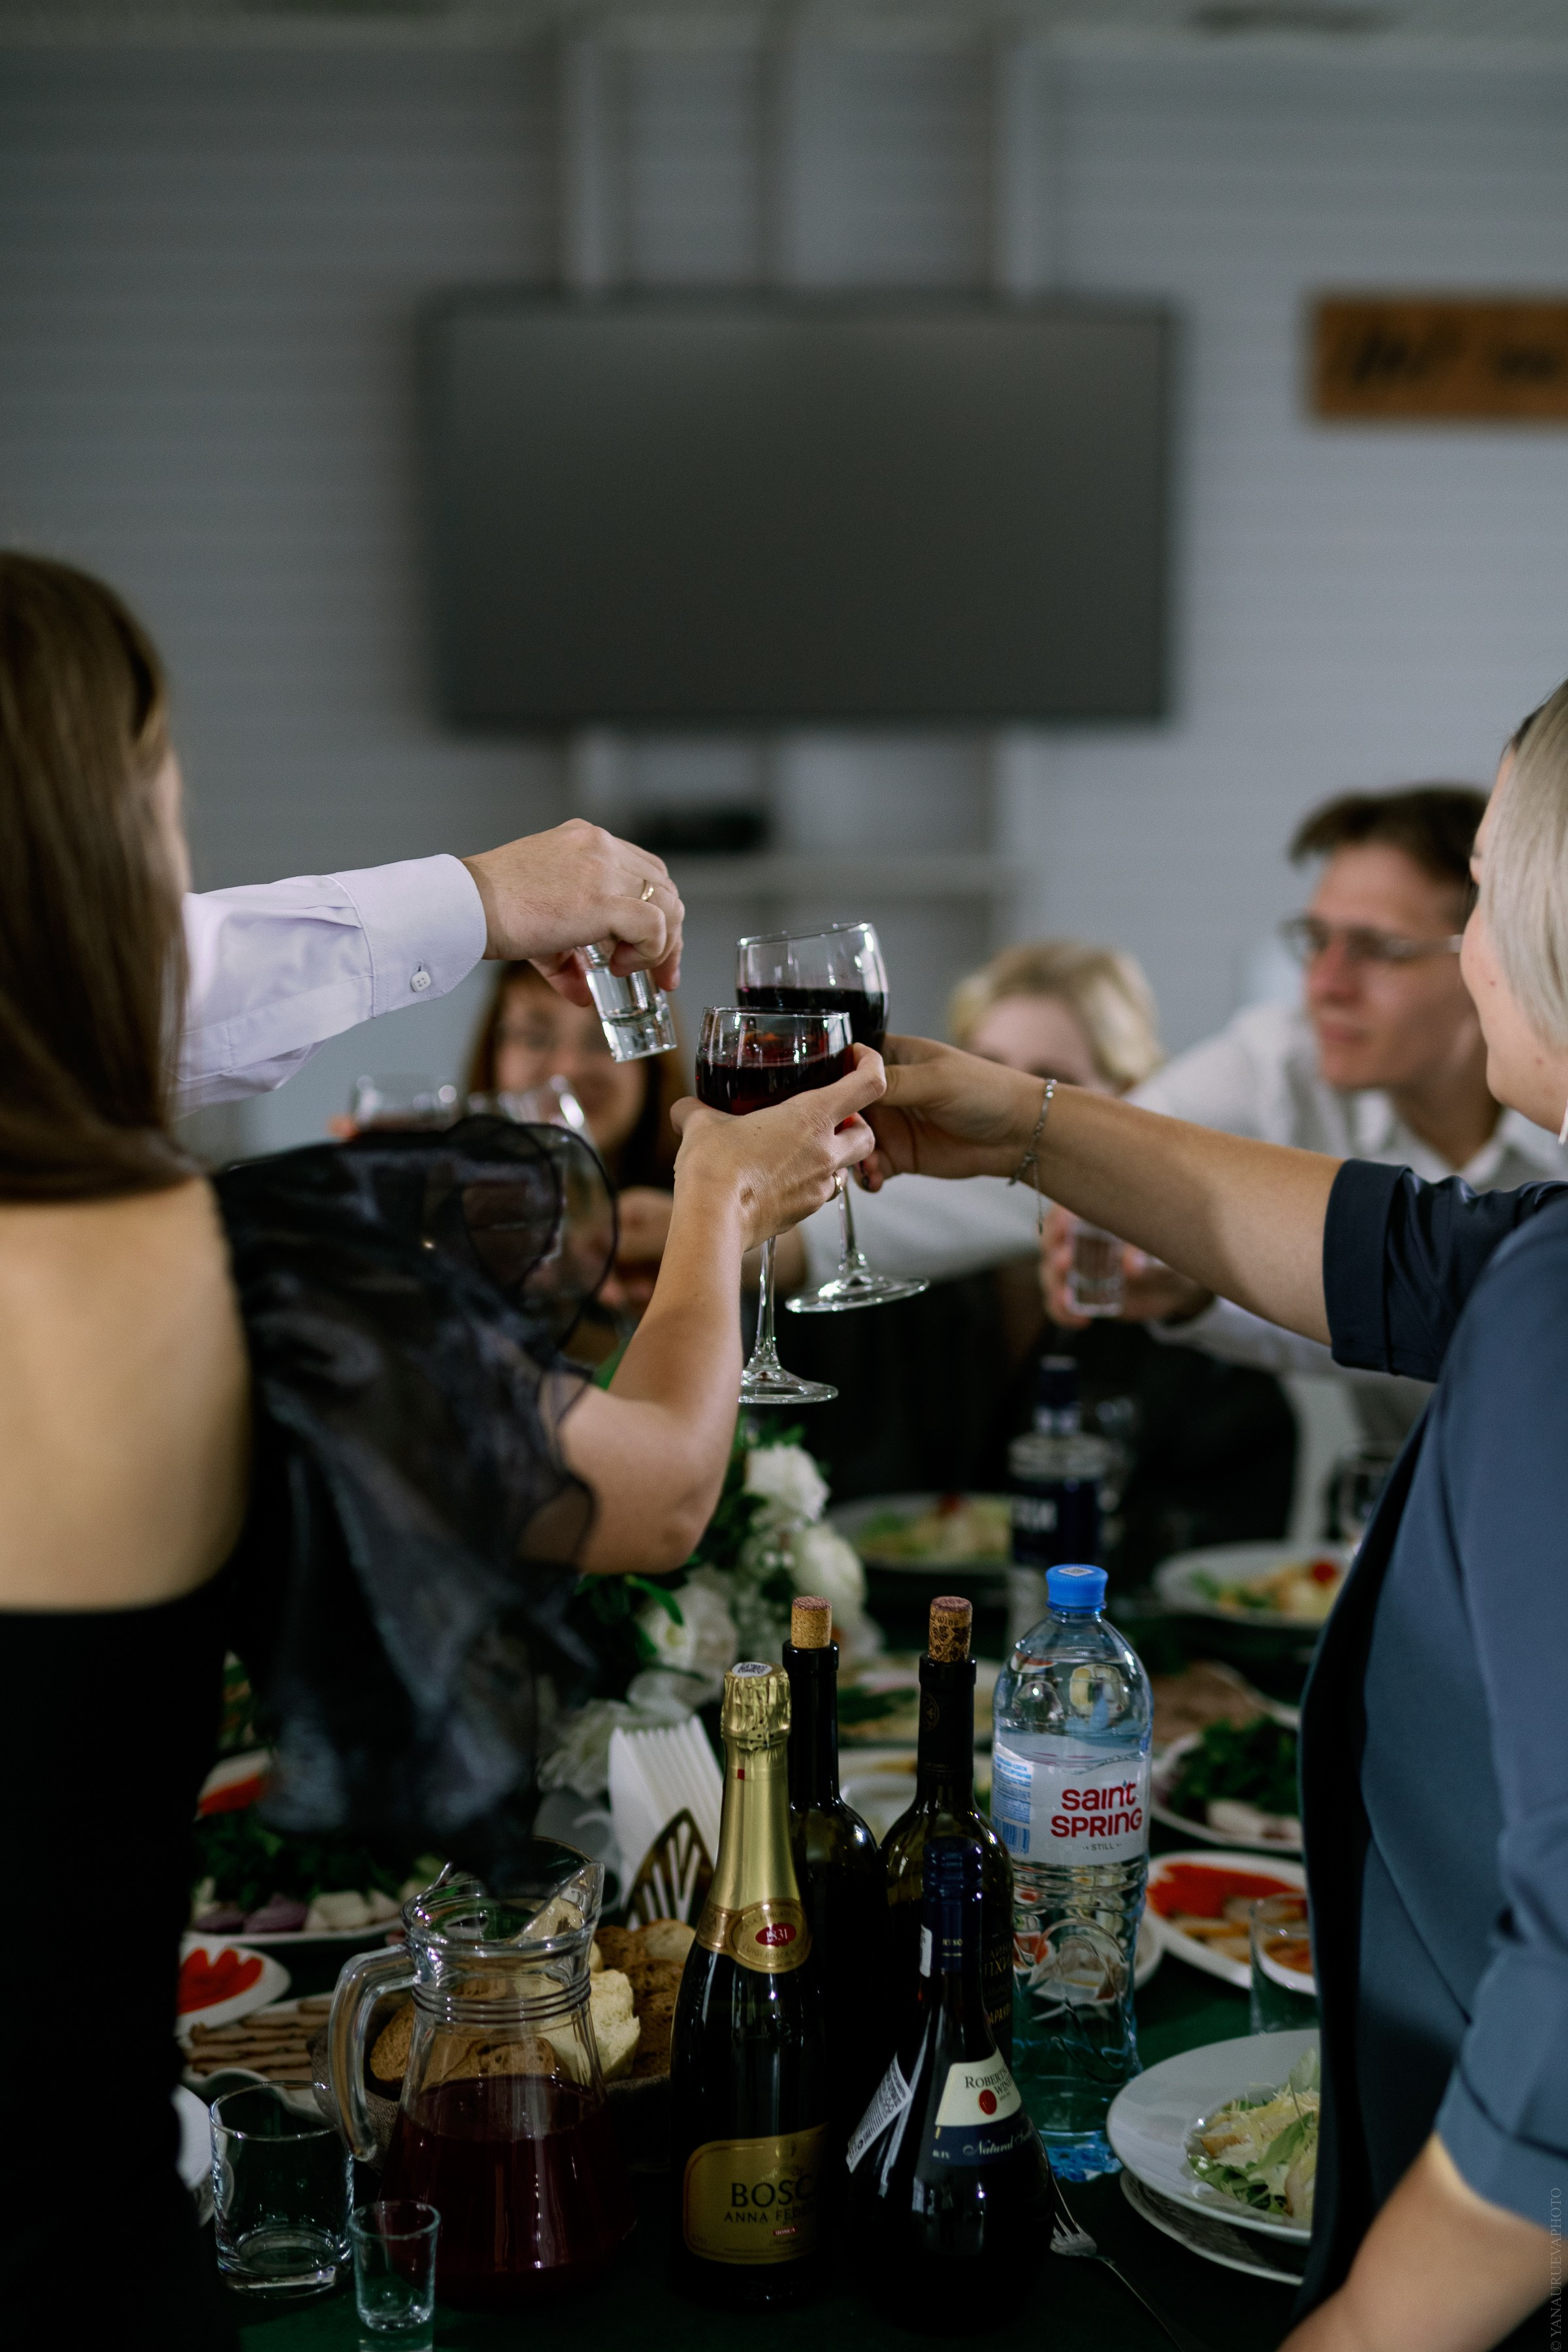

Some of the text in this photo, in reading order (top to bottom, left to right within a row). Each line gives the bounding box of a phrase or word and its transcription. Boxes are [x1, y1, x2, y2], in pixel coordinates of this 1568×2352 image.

[1061, 1783, 1136, 1810] saint
[1051, 1808, 1142, 1837] SPRING
[766, 1928, 788, 1943] 1831
[963, 2134, 1013, 2156] Natural
[724, 2212, 768, 2223] ANNA
